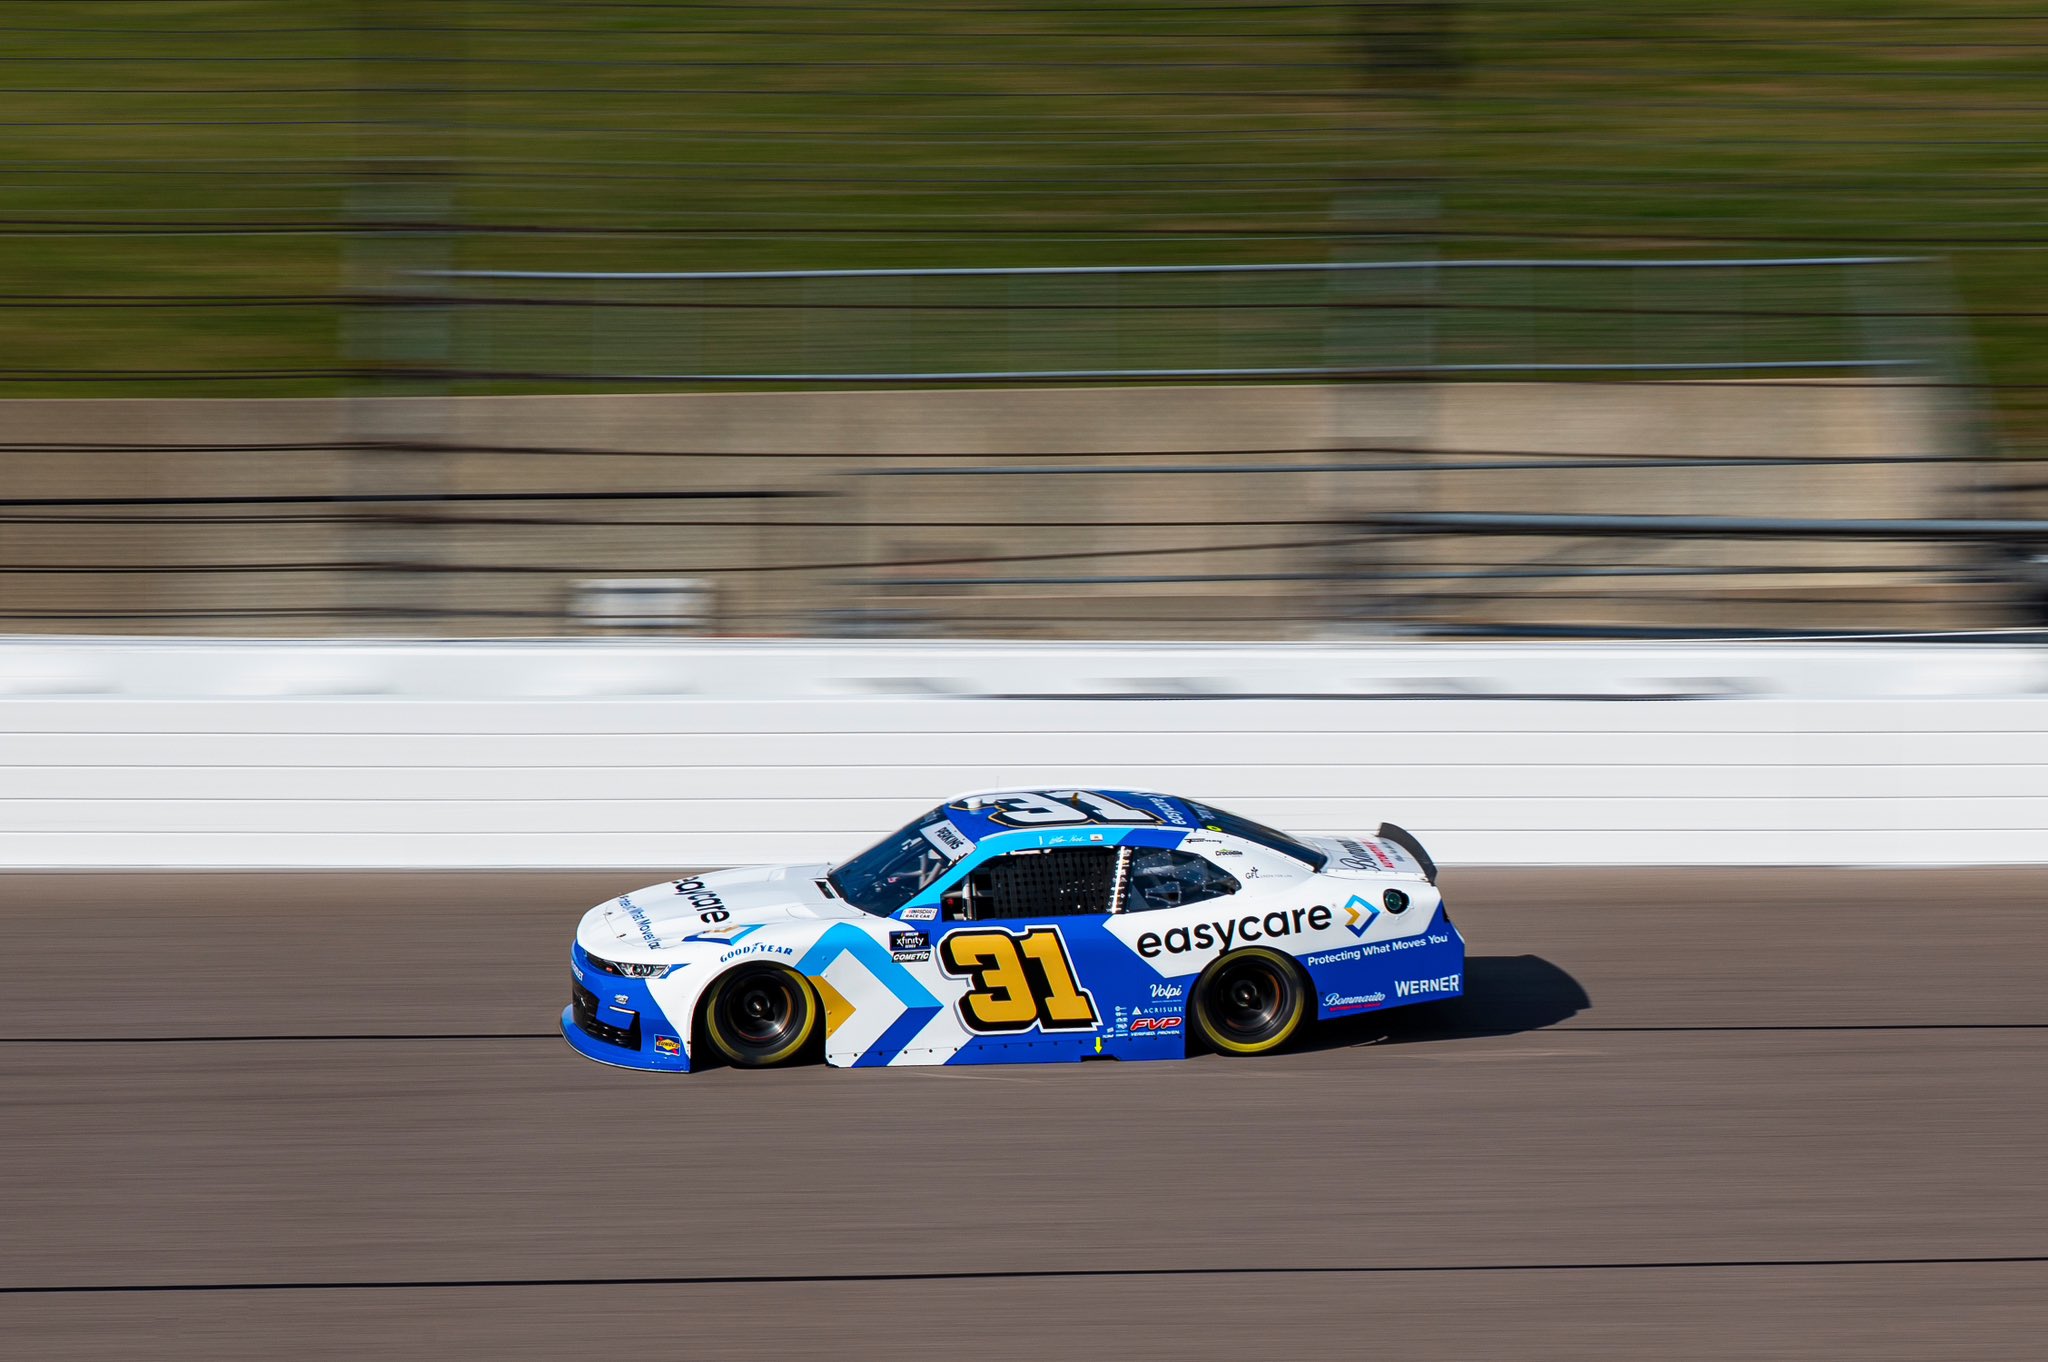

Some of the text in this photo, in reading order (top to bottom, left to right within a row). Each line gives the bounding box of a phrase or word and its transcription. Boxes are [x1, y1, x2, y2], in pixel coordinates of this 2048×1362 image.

[934, 826, 964, 850] PERKINS
[1136, 904, 1333, 959] easycare
[896, 936, 924, 947] xfinity
[1307, 934, 1448, 967] Protecting What Moves You
[893, 952, 930, 961] COMETIC
[939, 927, 1100, 1032] 31
[1395, 974, 1460, 998] WERNER
[1149, 984, 1182, 999] Volpi
[1143, 1006, 1182, 1014] ACRISURE
[1130, 1017, 1182, 1031] FVP
